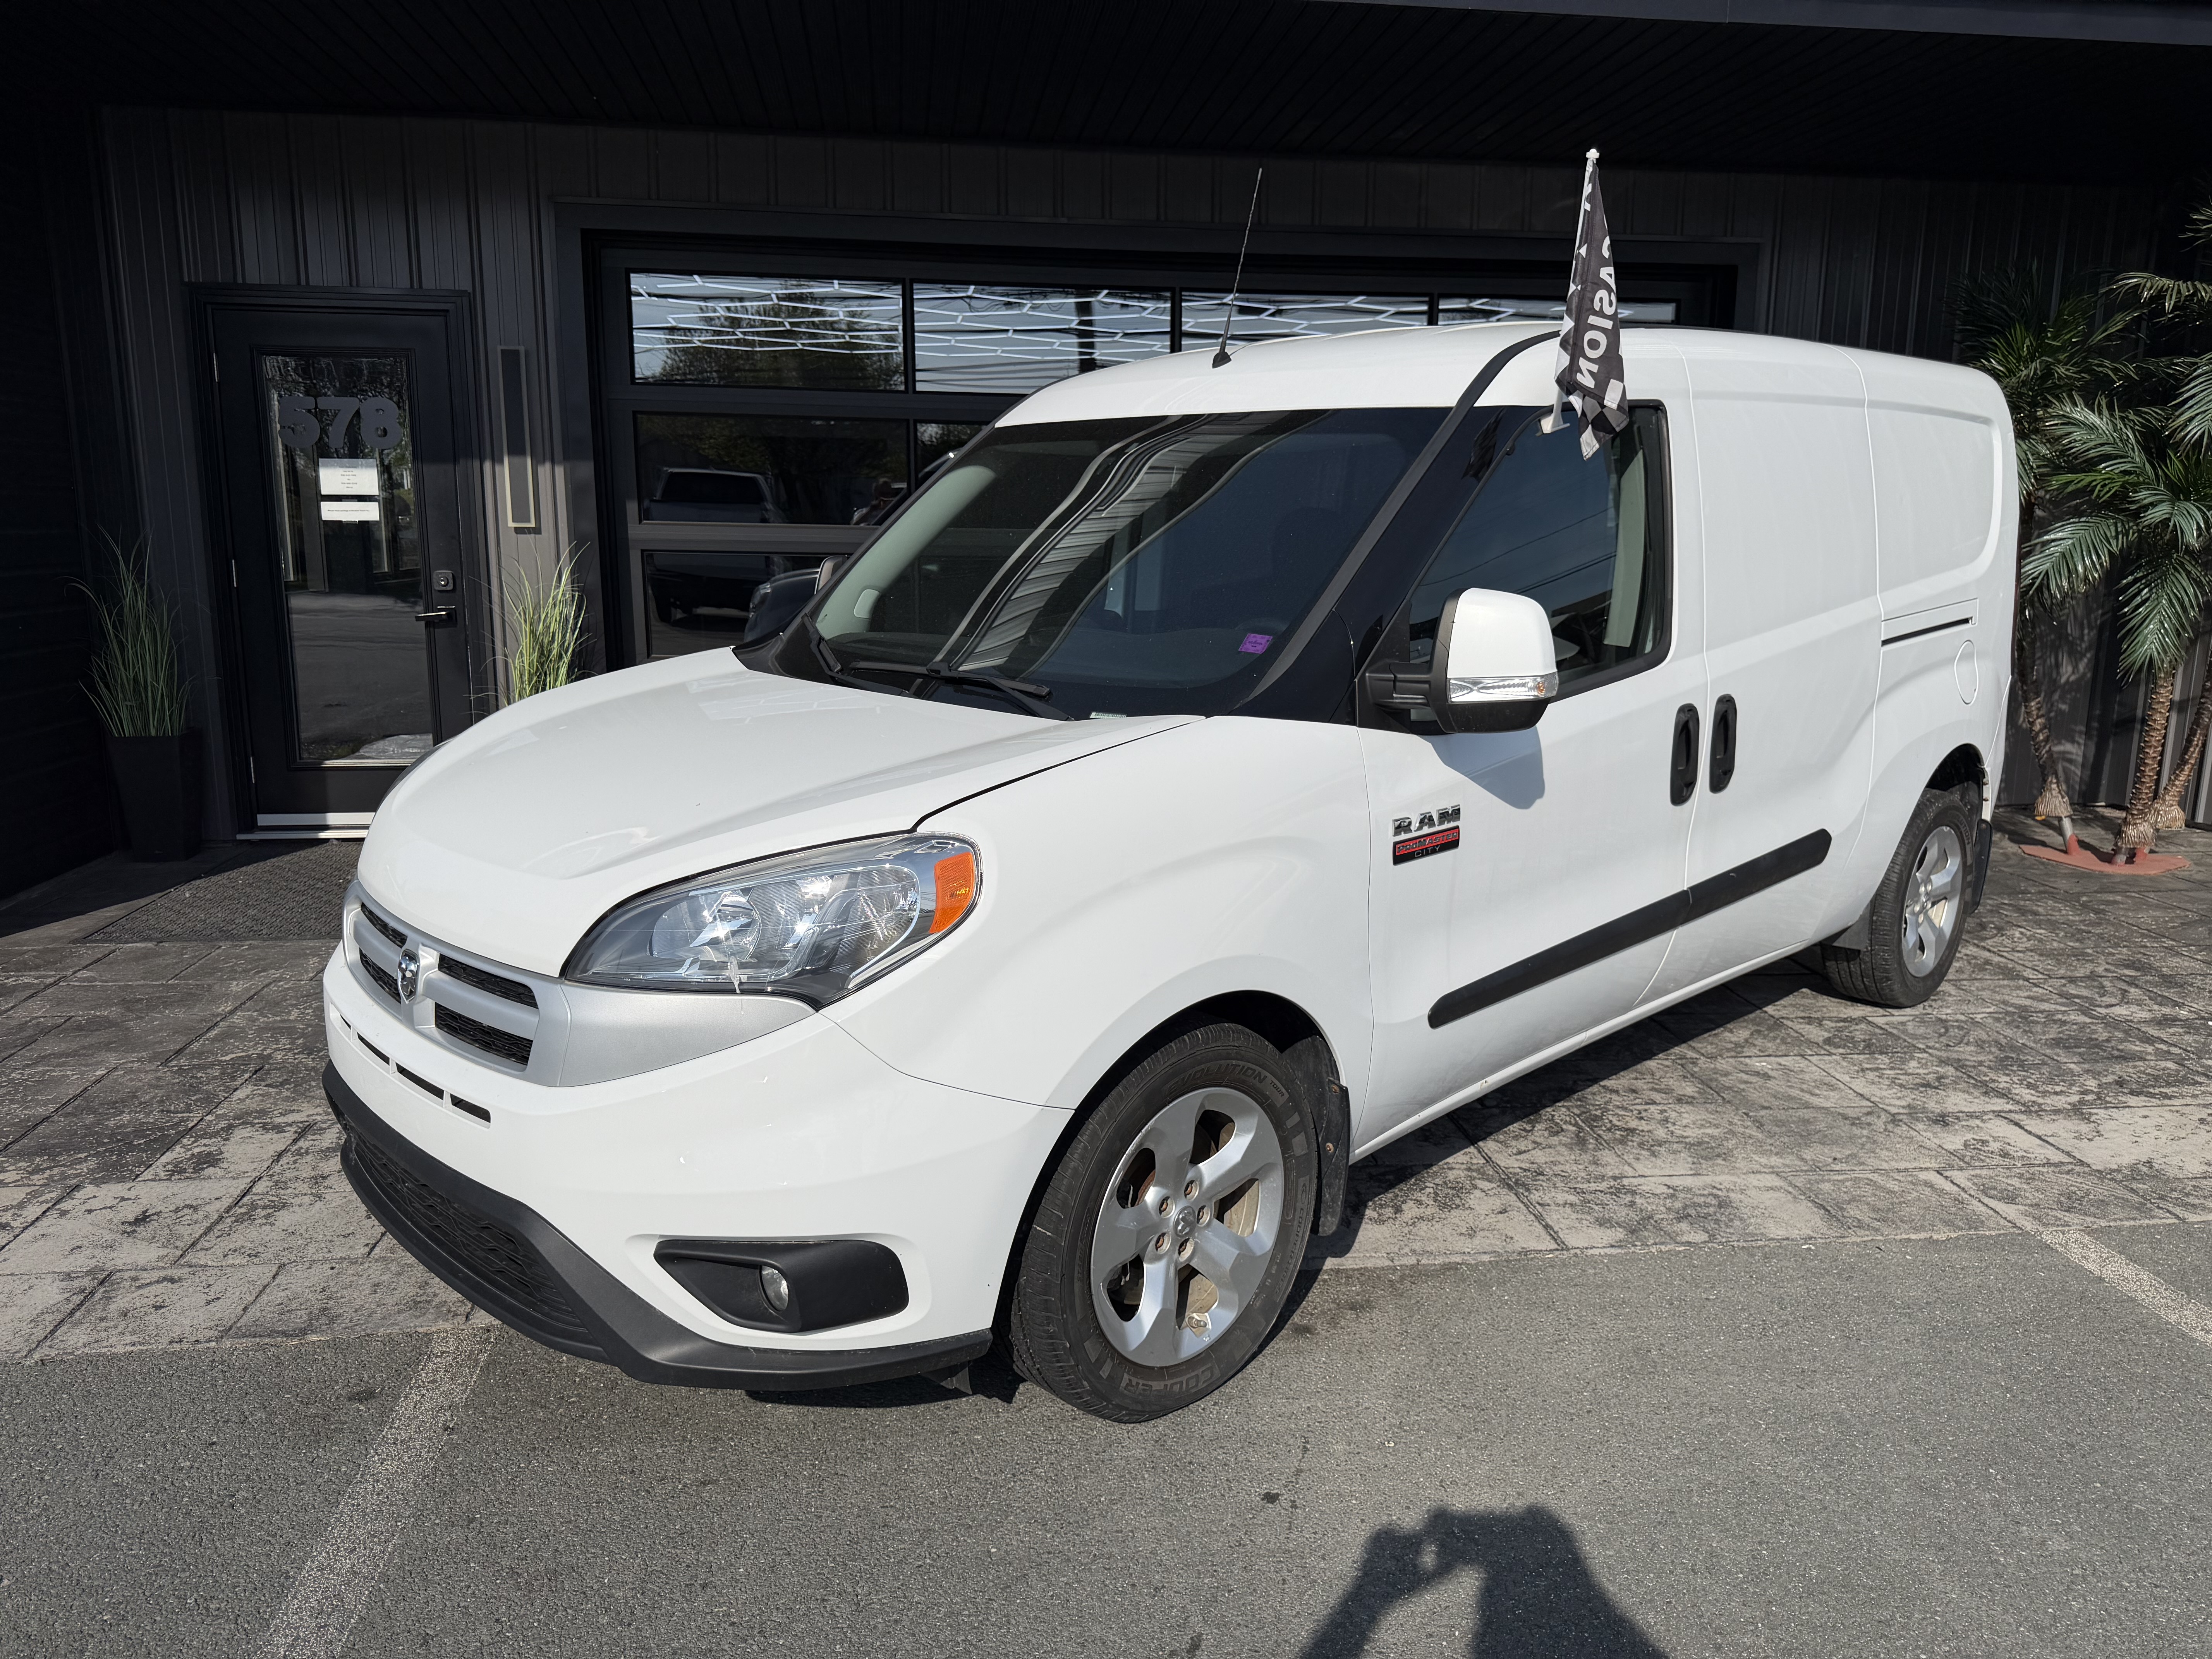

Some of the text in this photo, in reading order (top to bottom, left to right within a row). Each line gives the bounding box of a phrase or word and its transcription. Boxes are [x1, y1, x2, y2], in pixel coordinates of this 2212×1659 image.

[278, 396, 403, 449] 578
[1392, 804, 1460, 837] RAM
[1414, 845, 1441, 857] CITY
[1166, 1063, 1285, 1097] EVOLUTION TOUR
[1289, 1207, 1304, 1259] COOPER
